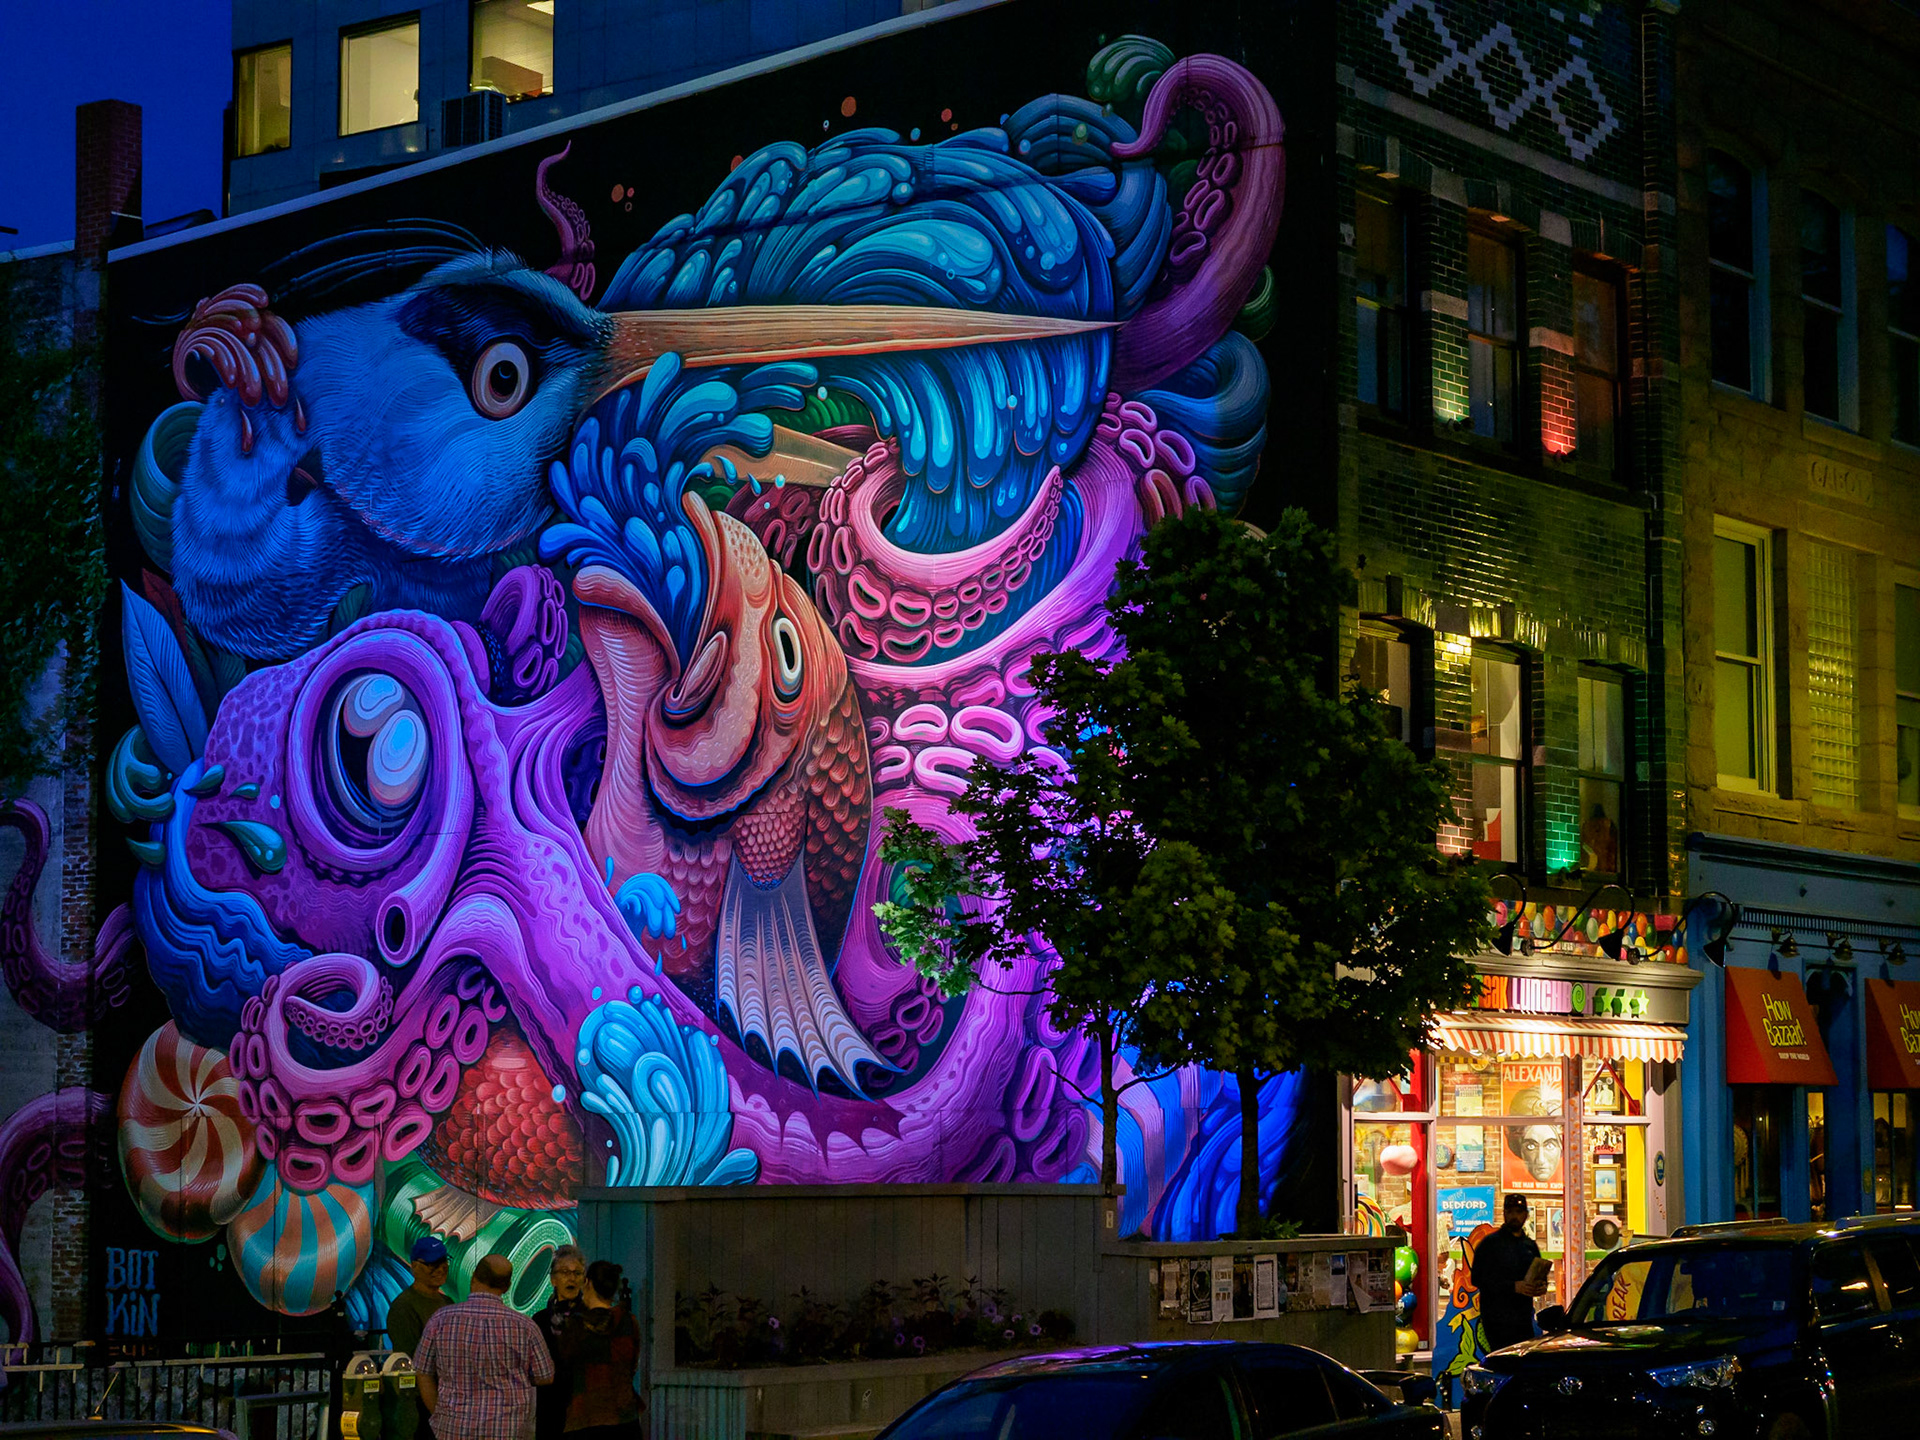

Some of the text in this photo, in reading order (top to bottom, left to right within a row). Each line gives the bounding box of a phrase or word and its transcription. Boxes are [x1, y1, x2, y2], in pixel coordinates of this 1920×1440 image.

[1898, 1003, 1920, 1030] Ho
[1762, 1017, 1808, 1047] Bazaar!
[1503, 1065, 1562, 1083] ALEXAND
[1442, 1200, 1487, 1210] BEDFORD
[105, 1246, 160, 1291] BOT
[1612, 1272, 1632, 1320] REAK
